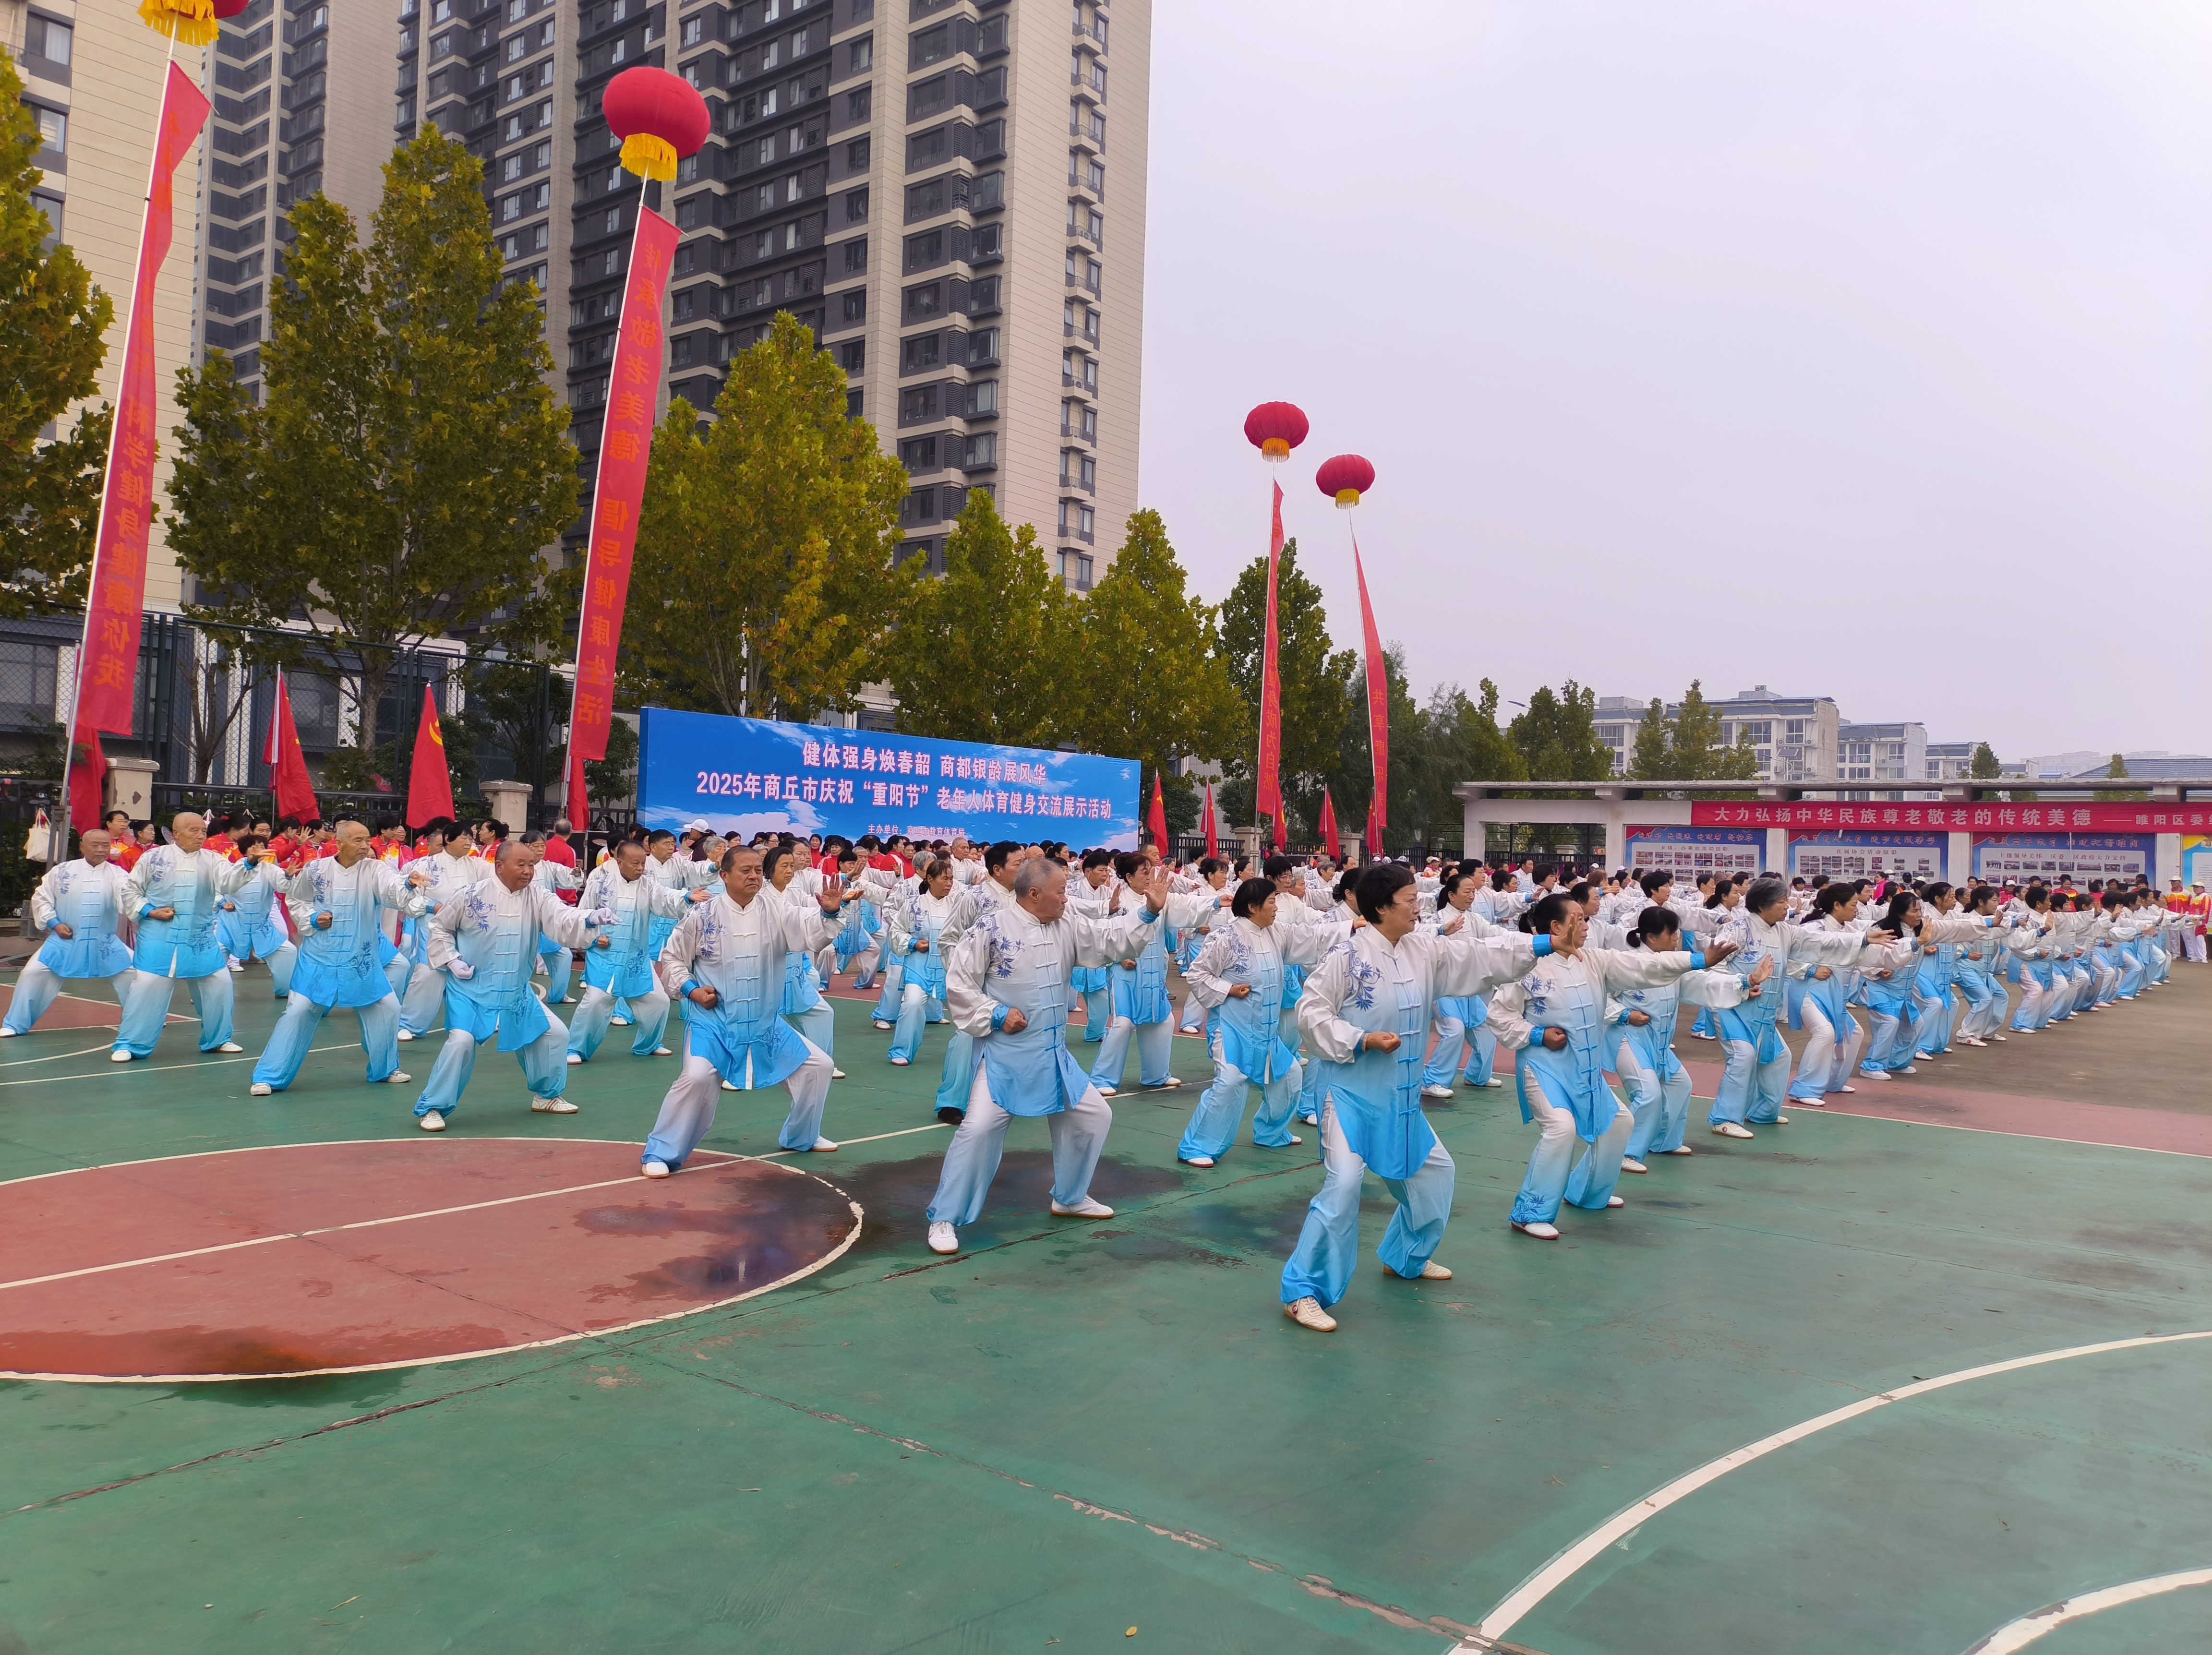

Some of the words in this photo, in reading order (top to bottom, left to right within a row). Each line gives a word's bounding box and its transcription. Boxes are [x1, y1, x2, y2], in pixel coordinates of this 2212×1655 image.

[802, 740, 931, 776] 健体强身焕春韶
[939, 754, 1047, 785] 商都银龄展风华
[696, 770, 1112, 821] 2025年商丘市庆祝“重阳节”老年人体育健身交流展示活动
[1714, 807, 2091, 825] 大力弘扬中华民族尊老敬老的传统美德
